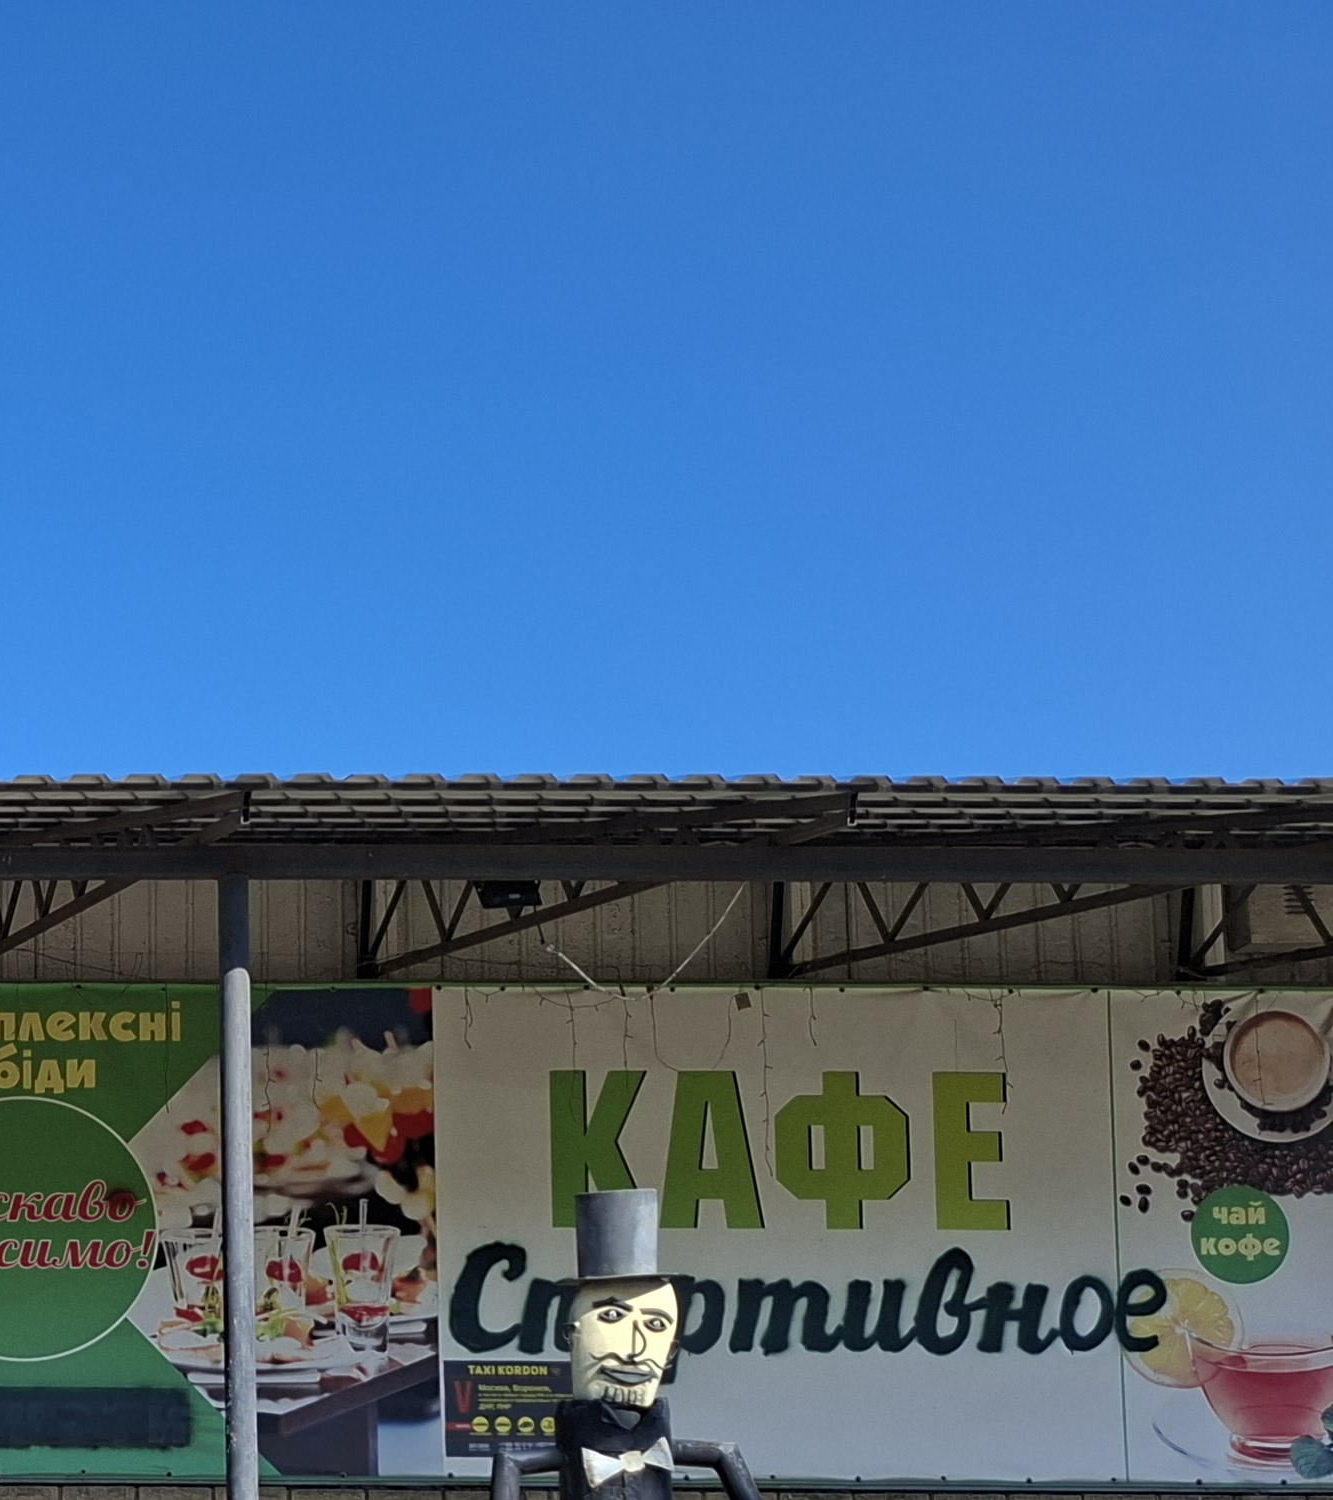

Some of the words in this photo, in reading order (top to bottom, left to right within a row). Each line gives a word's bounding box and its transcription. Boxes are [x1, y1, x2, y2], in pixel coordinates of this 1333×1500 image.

[549, 1071, 1012, 1230] КАФЕ
[1212, 1201, 1266, 1225] чай
[1200, 1233, 1281, 1261] кофе
[449, 1241, 1168, 1384] Спртивное
[467, 1365, 495, 1375] TAXI
[497, 1365, 548, 1376] KORDON
